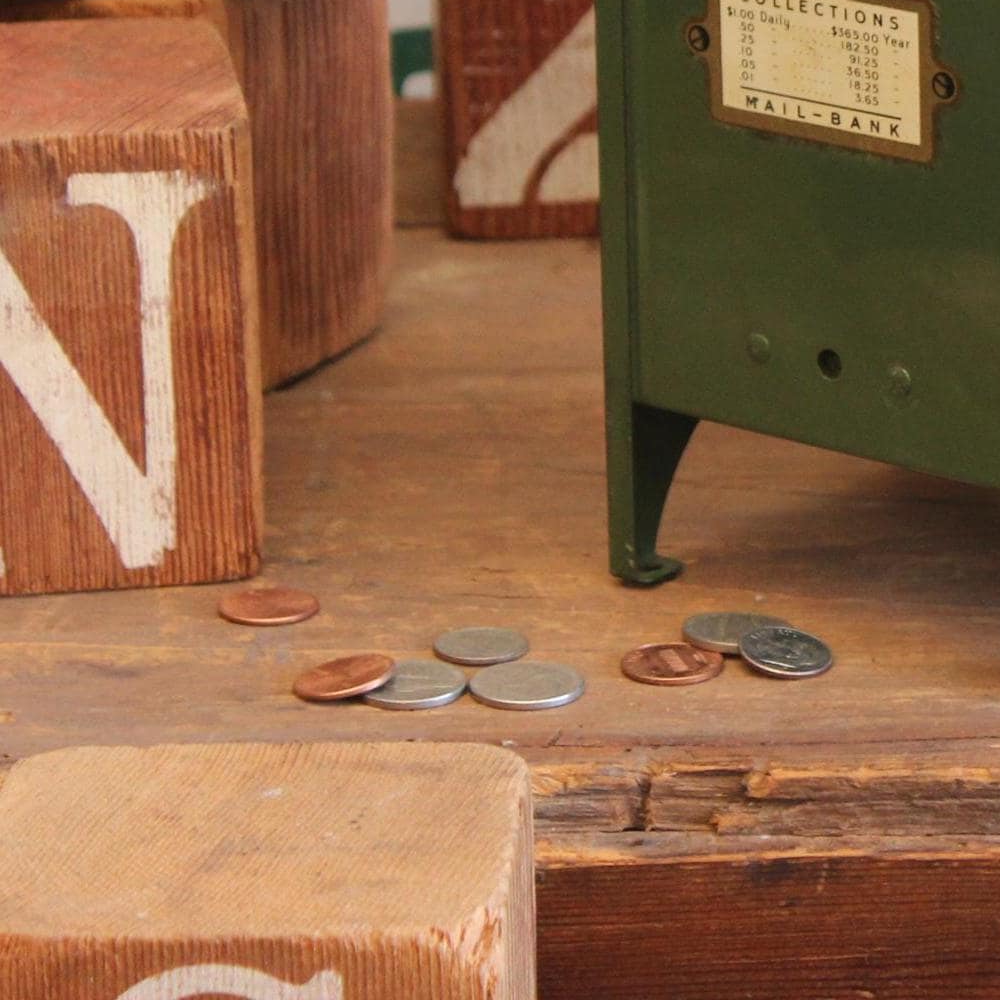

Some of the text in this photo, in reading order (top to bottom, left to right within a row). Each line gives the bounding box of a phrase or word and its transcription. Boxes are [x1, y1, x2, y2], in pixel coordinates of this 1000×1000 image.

[727, 6, 910, 49] $1.00 Daily $365.00 Year
[849, 54, 879, 69] 91.25
[846, 66, 879, 81] 36.50
[855, 92, 879, 106] 3.65
[745, 95, 901, 138] MAIL-BANK
